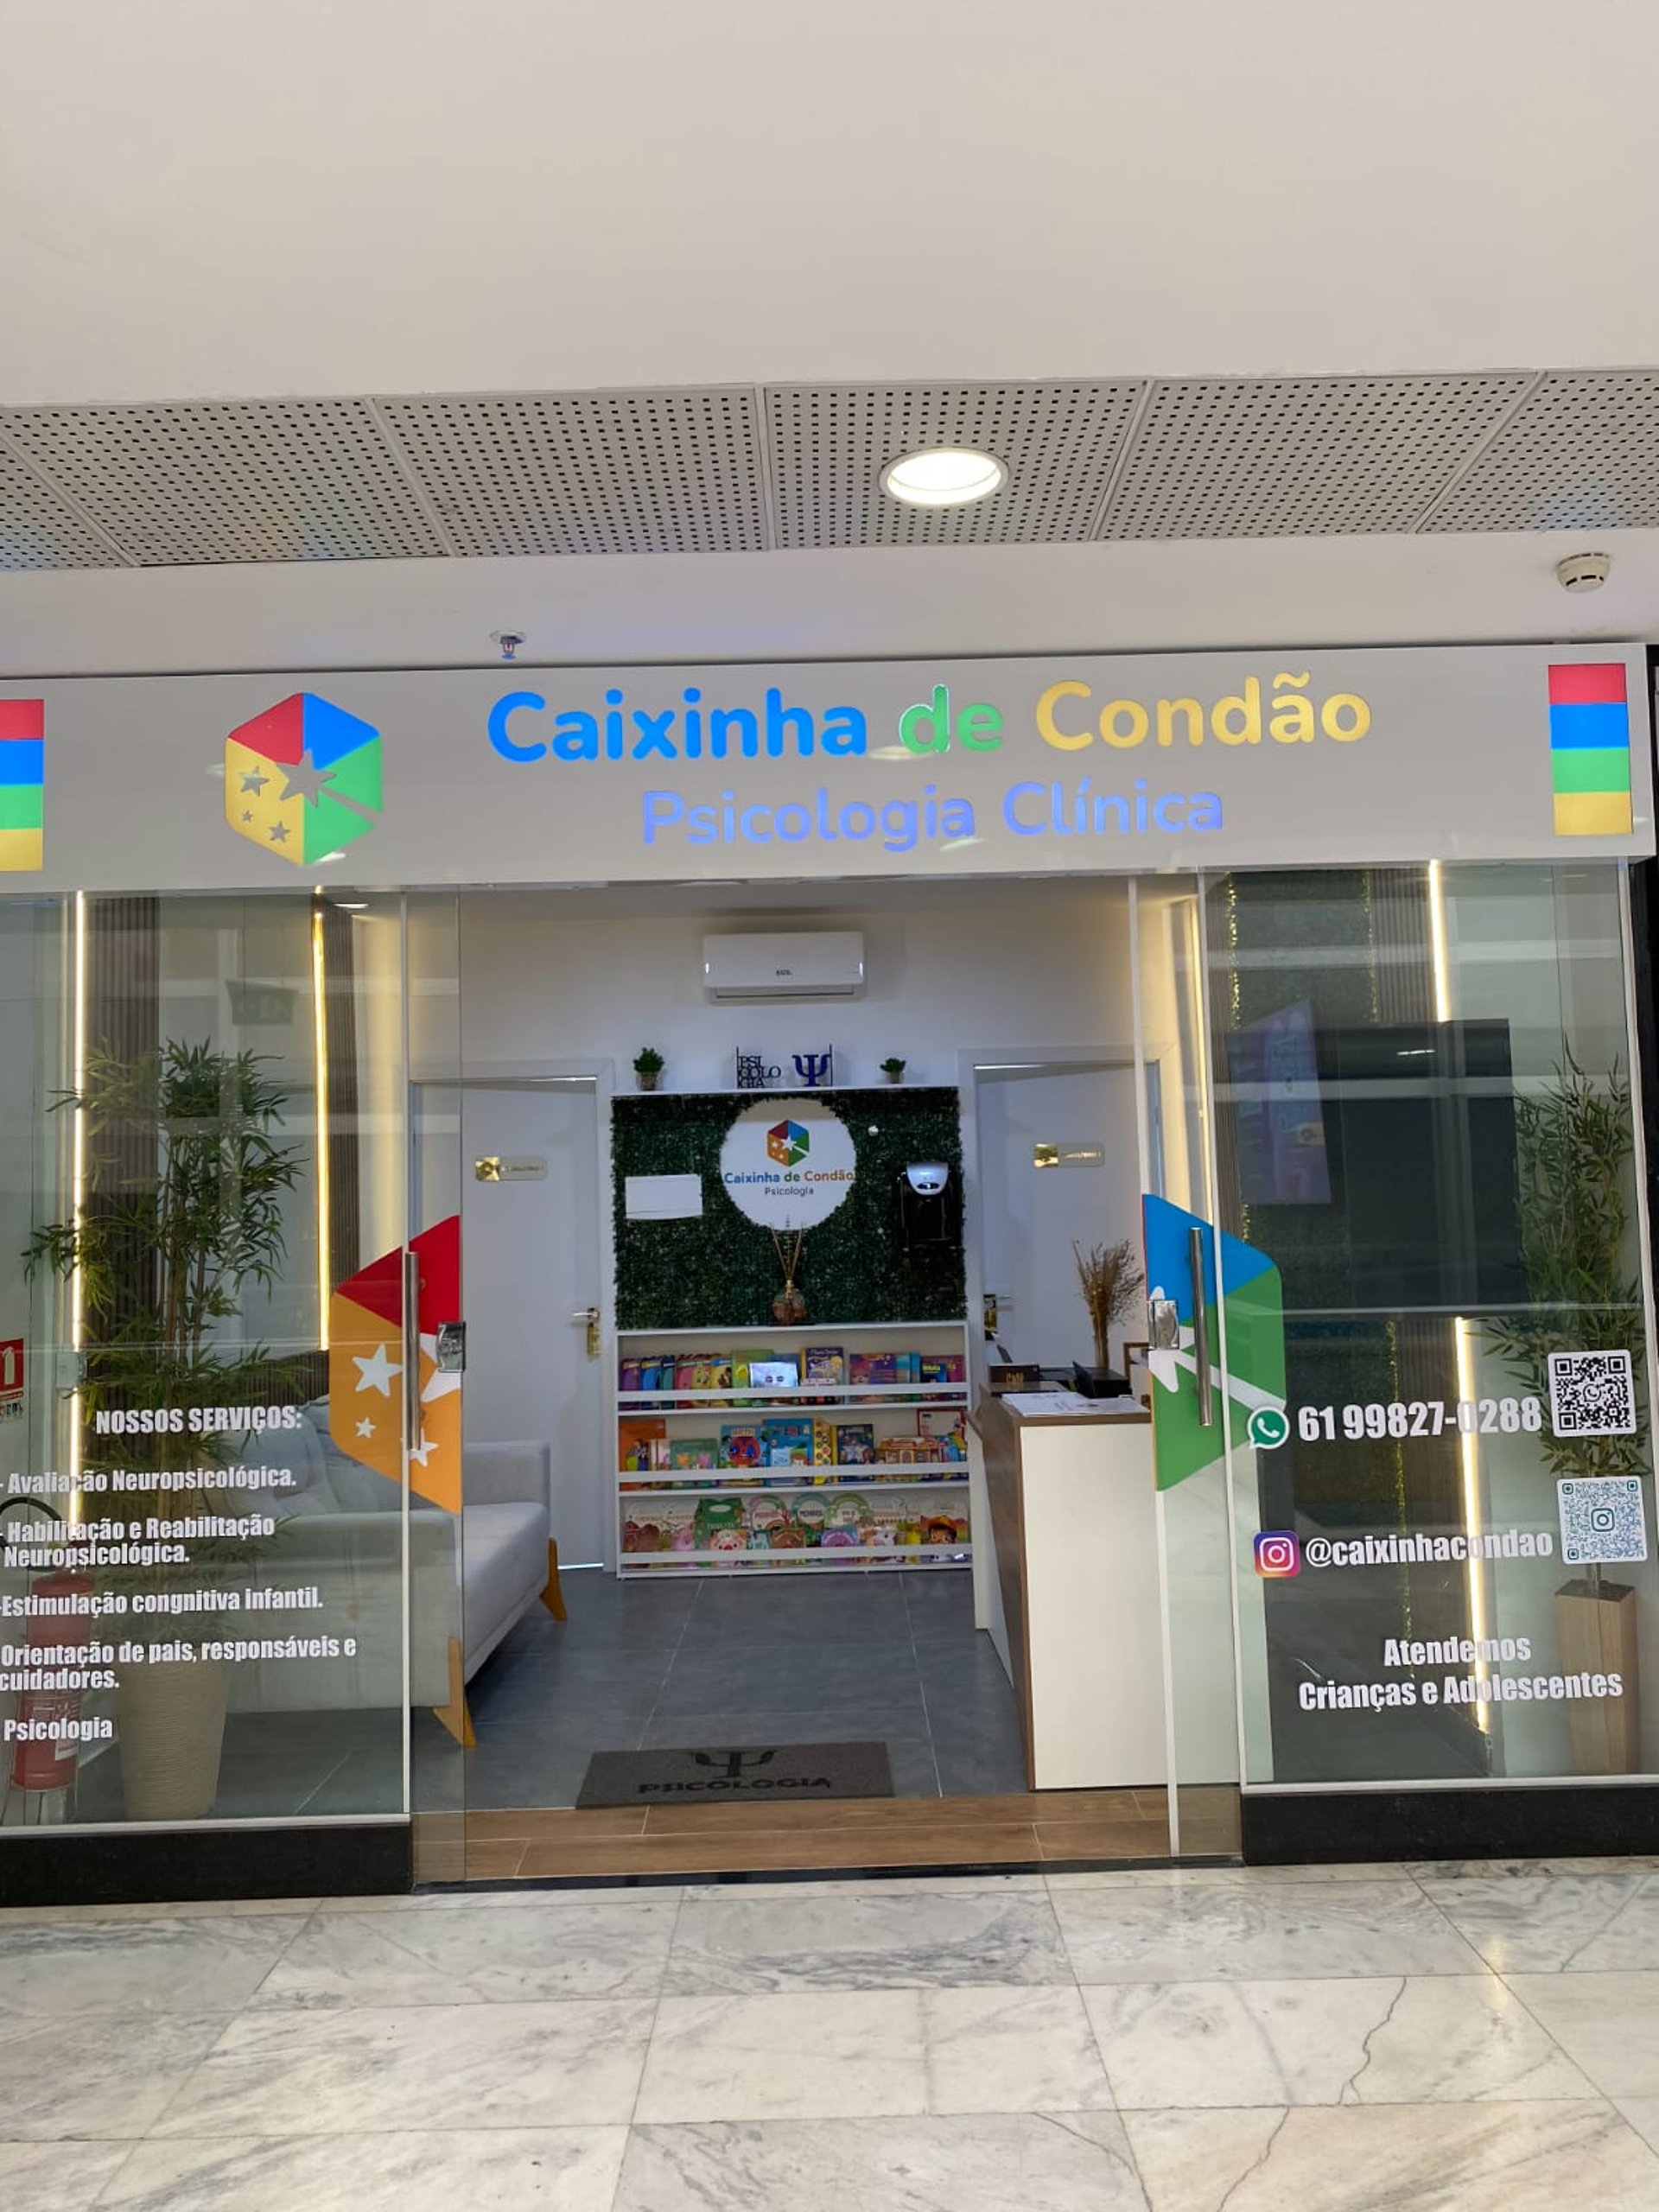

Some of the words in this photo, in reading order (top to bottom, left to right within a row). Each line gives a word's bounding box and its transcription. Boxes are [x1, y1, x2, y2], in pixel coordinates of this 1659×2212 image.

[487, 688, 867, 762] Caixinha
[899, 683, 1004, 753] de
[1037, 672, 1371, 751] Condão
[642, 784, 976, 852] Psicologia
[1002, 778, 1224, 836] Clínica
[724, 1172, 780, 1184] Caixinha
[784, 1172, 800, 1181] de
[804, 1170, 855, 1181] Condão
[765, 1186, 814, 1197] Psicologia
[96, 1408, 183, 1434] NOSSOS
[188, 1405, 302, 1433] SERVIÇOS:
[1299, 1406, 1337, 1441] 61
[1344, 1397, 1542, 1438] 99827-0288
[8, 1470, 108, 1493] Avaliação
[112, 1466, 297, 1491] Neuropsicológica.
[8, 1518, 124, 1545] Habilitação
[130, 1521, 141, 1540] e
[146, 1514, 275, 1540] Reabilitação
[4, 1543, 189, 1568] Neuropsicológica.
[1306, 1529, 1553, 1567] @caixinhacondao
[2, 1592, 127, 1618] Estimulação
[132, 1588, 240, 1614] congnitiva
[245, 1586, 324, 1610] infantil.
[1, 1641, 114, 1669] Orientação
[119, 1641, 145, 1662] de
[149, 1640, 197, 1664] pais,
[201, 1636, 340, 1661] responsáveis
[344, 1638, 356, 1656] e
[1383, 1637, 1531, 1667] Atendemos
[0, 1668, 119, 1691] cuidadores.
[1299, 1679, 1416, 1713] Crianças
[1422, 1681, 1439, 1705] e
[1443, 1673, 1623, 1704] Adolescentes
[3, 1717, 113, 1741] Psicologia
[637, 1777, 831, 1794] PSICOLOGIA
